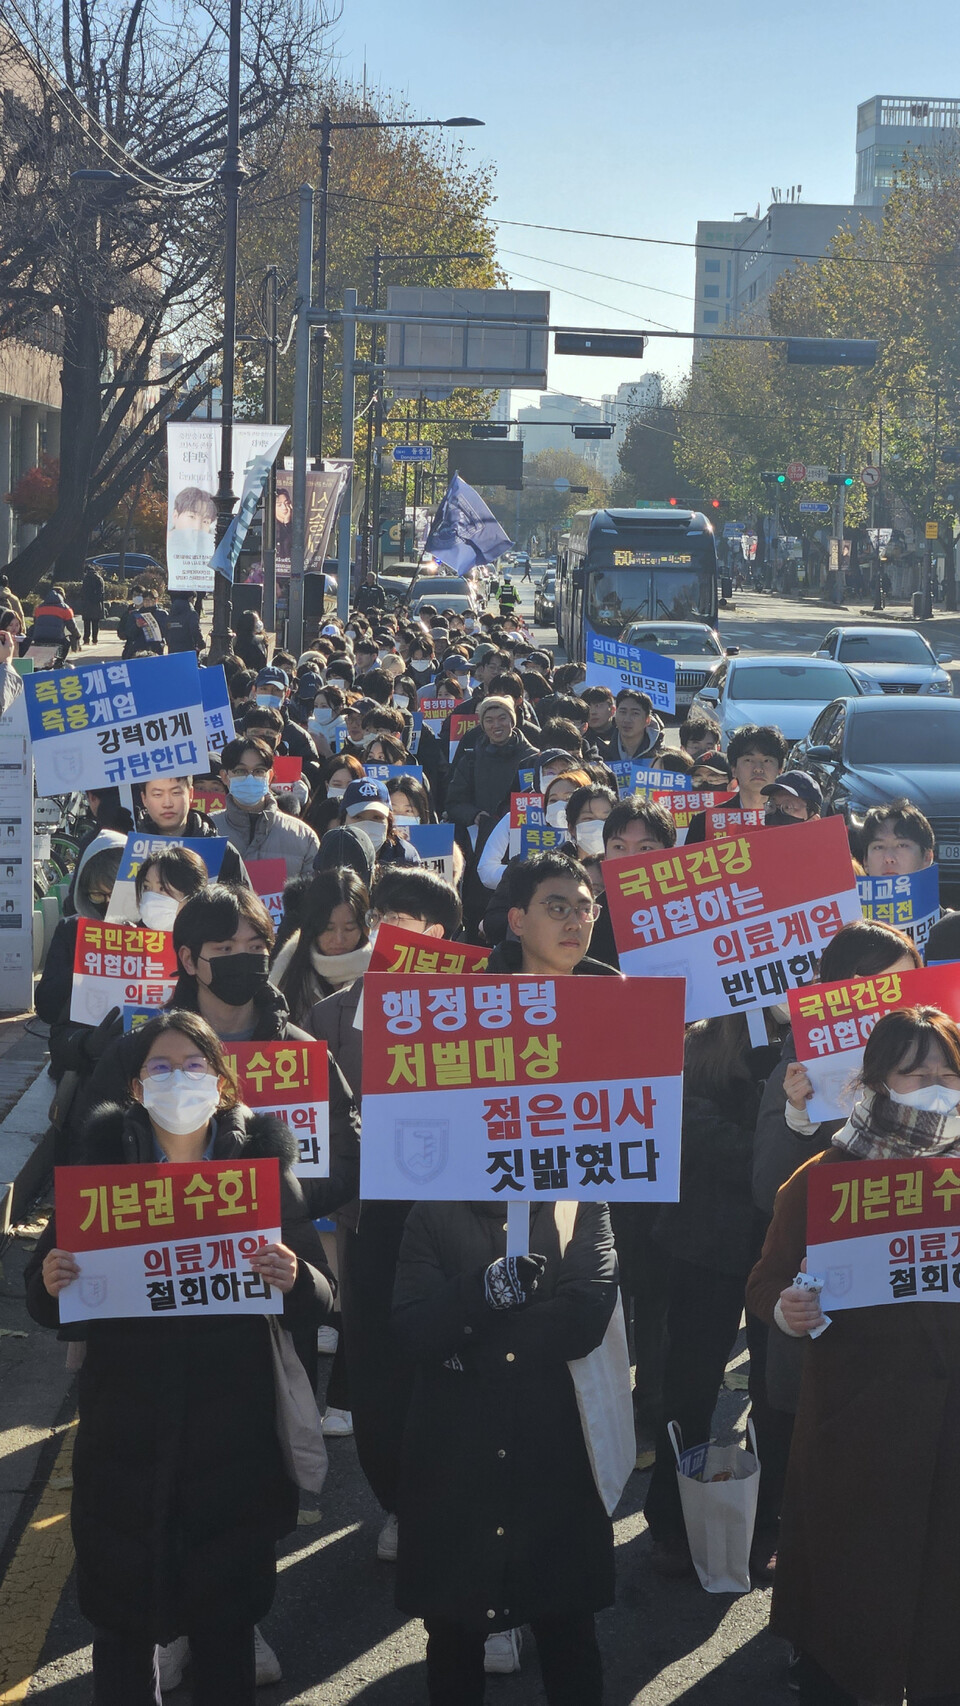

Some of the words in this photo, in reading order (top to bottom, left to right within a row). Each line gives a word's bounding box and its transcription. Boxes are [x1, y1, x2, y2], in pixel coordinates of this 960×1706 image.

[593, 638, 641, 660] 의대교육
[593, 651, 642, 674] 붕괴직전
[34, 663, 132, 705] 즉흥개혁
[620, 672, 668, 694] 의대모집
[40, 692, 138, 733] 즉흥계엄
[423, 699, 455, 710] 행정명령
[97, 711, 193, 754] 강력하게
[103, 741, 198, 783] 규탄한다
[362, 765, 390, 779] 교육
[635, 770, 686, 789] 의대교육
[658, 791, 715, 811] 행정명령
[617, 838, 752, 901] 국민건강
[856, 875, 912, 901] 대교육
[631, 882, 764, 944] 위협하는
[712, 900, 844, 967] 의료계엄
[84, 926, 166, 954] 국민건강
[84, 951, 165, 979] 위협하는
[721, 949, 823, 1007] 반대한
[381, 980, 558, 1035] 행정명령
[798, 973, 903, 1021] 국민건강
[245, 1048, 310, 1093] 수호!
[386, 1033, 562, 1088] 처벌대상
[481, 1085, 657, 1141] 젊은의사
[485, 1138, 660, 1194] 짓밟혔다
[79, 1174, 175, 1234] 기본권
[183, 1167, 259, 1221] 수호!
[829, 1170, 924, 1224] 기본권
[931, 1167, 960, 1212] 수
